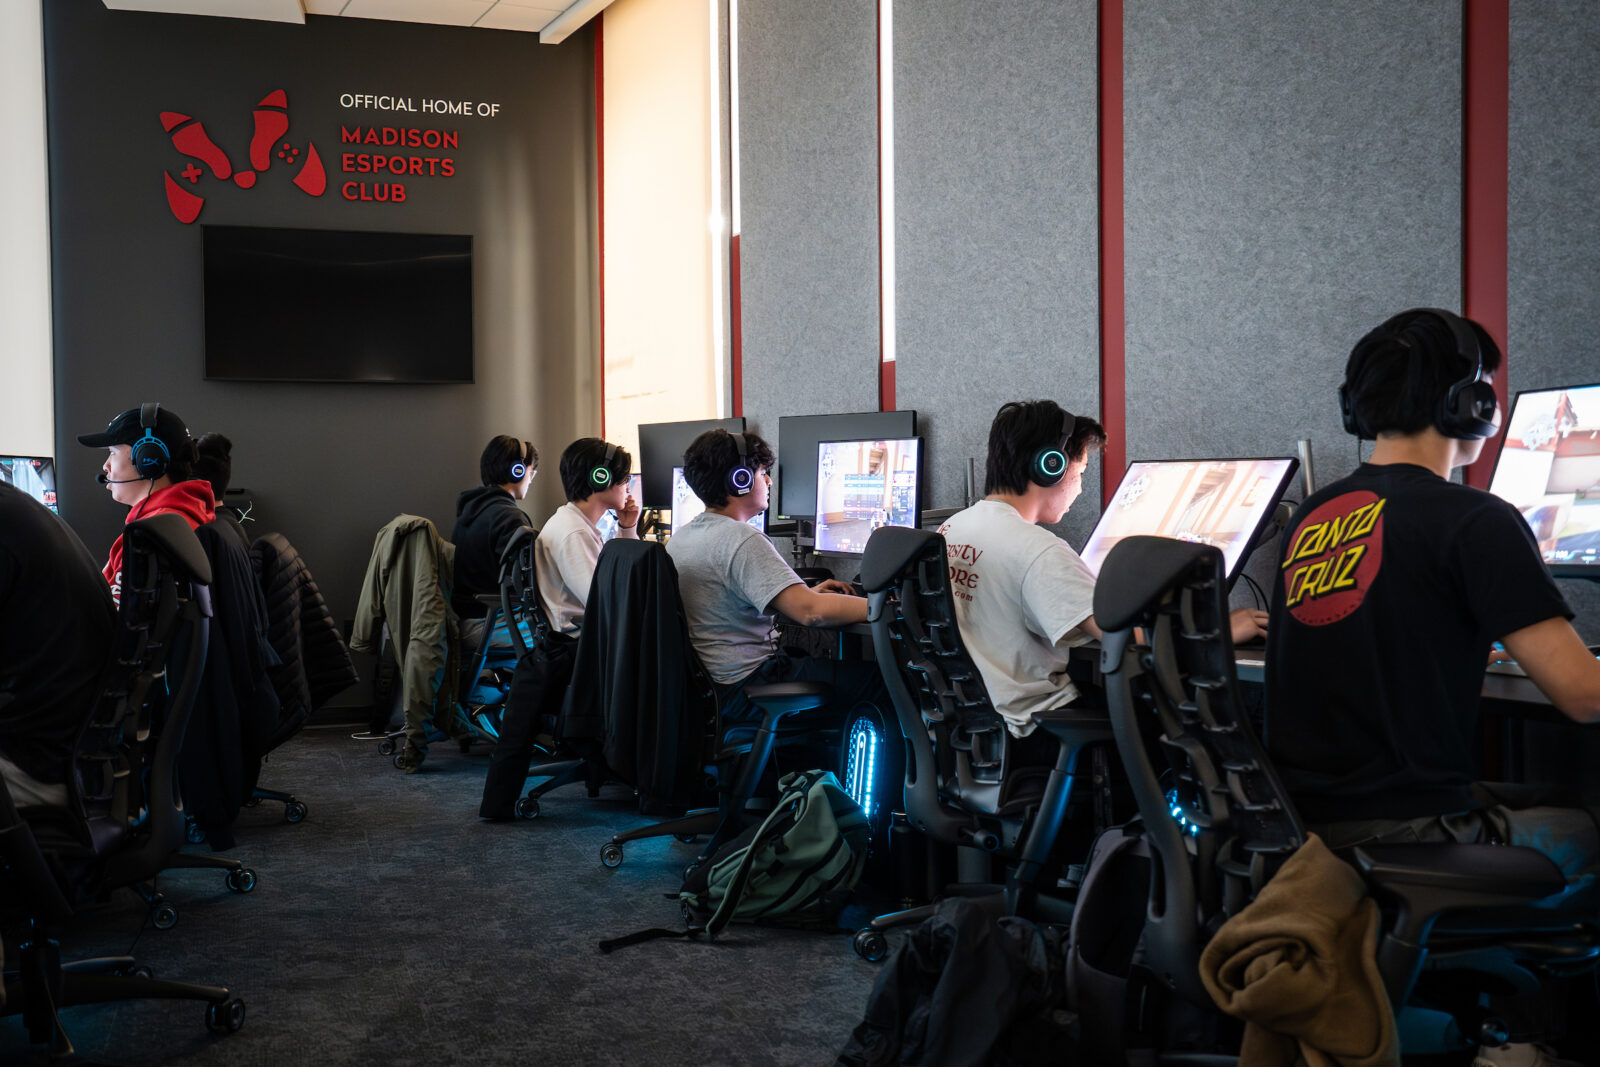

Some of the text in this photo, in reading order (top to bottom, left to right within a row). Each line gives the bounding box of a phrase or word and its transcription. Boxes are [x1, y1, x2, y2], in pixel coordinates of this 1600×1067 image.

[340, 93, 501, 117] OFFICIAL HOME OF
[341, 125, 458, 149] MADISON
[342, 153, 455, 177] ESPORTS
[342, 181, 406, 202] CLUB
[1281, 498, 1387, 569] SANTA
[1286, 544, 1367, 607] CRUZ
